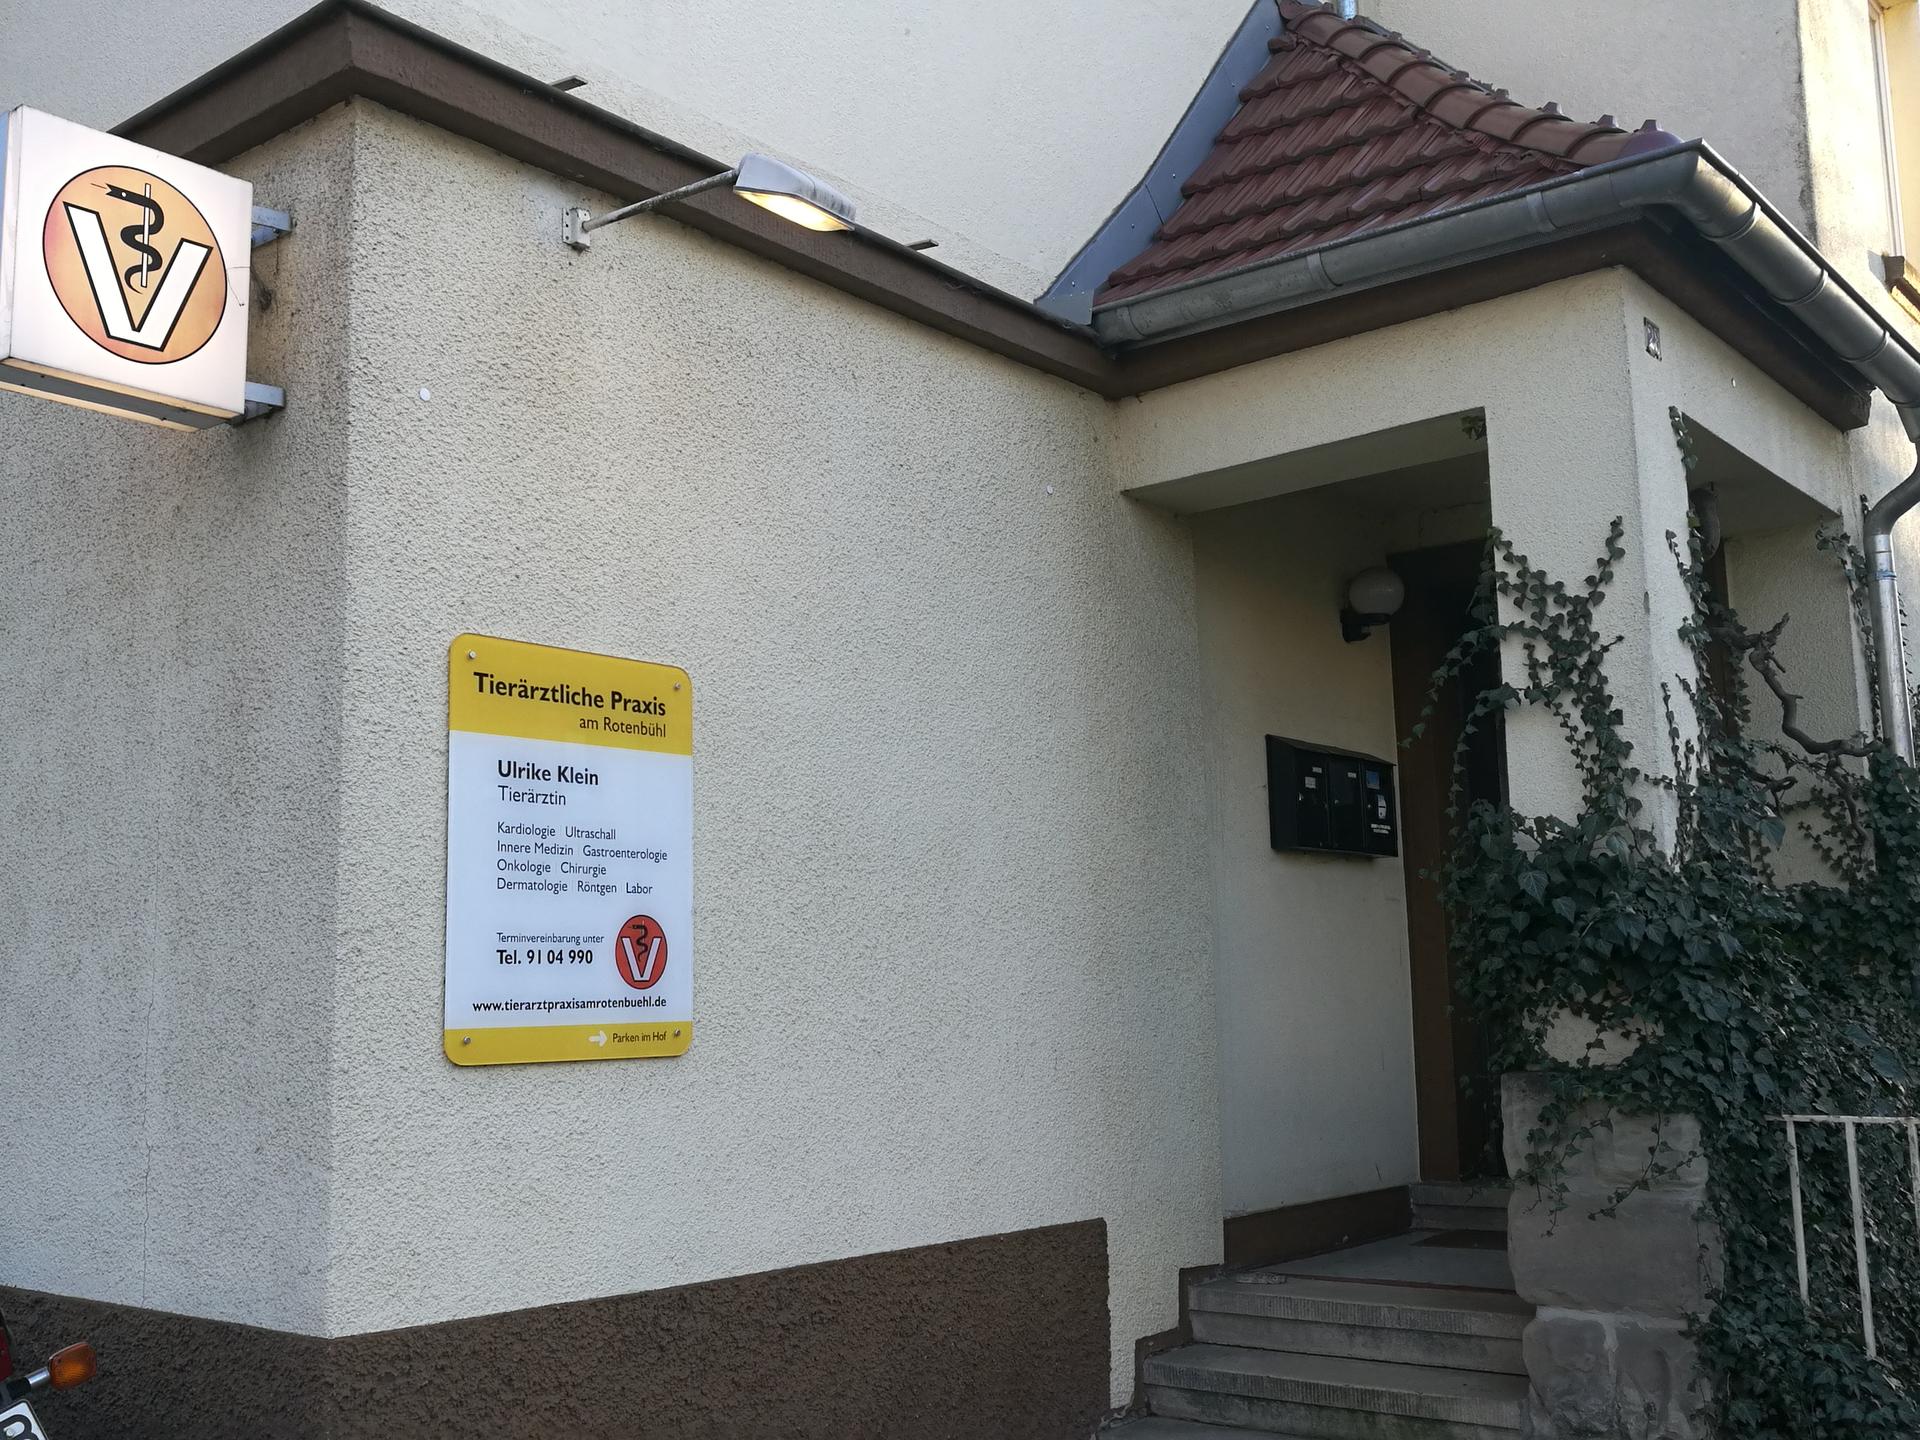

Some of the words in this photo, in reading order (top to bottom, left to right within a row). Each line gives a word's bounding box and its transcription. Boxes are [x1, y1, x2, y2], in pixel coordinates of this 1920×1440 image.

[473, 671, 604, 708] Tierärztliche
[610, 690, 666, 716] Praxis
[579, 718, 598, 730] am
[603, 716, 667, 738] Rotenbühl
[498, 760, 551, 781] Ulrike
[557, 765, 599, 785] Klein
[498, 785, 566, 805] Tierärztin
[497, 822, 556, 840] Kardiologie
[565, 826, 616, 840] Ultraschall
[497, 840, 530, 853] Innere
[534, 842, 573, 856] Medizin
[582, 845, 668, 862] Gastroenterologie
[497, 859, 551, 875] Onkologie
[560, 862, 607, 878] Chirurgie
[497, 878, 568, 895] Dermatologie
[577, 880, 617, 896] Röntgen
[626, 882, 653, 895] Labor
[497, 932, 581, 946] Terminvereinbarung
[582, 934, 604, 944] unter
[496, 949, 521, 965] Tel.
[526, 950, 542, 964] 91
[547, 950, 564, 965] 04
[569, 950, 593, 964] 990
[472, 996, 667, 1013] www.tierarztpraxisamrotenbuehl.de
[612, 1032, 639, 1043] Parken
[641, 1032, 651, 1042] im
[652, 1031, 667, 1042] Hof
